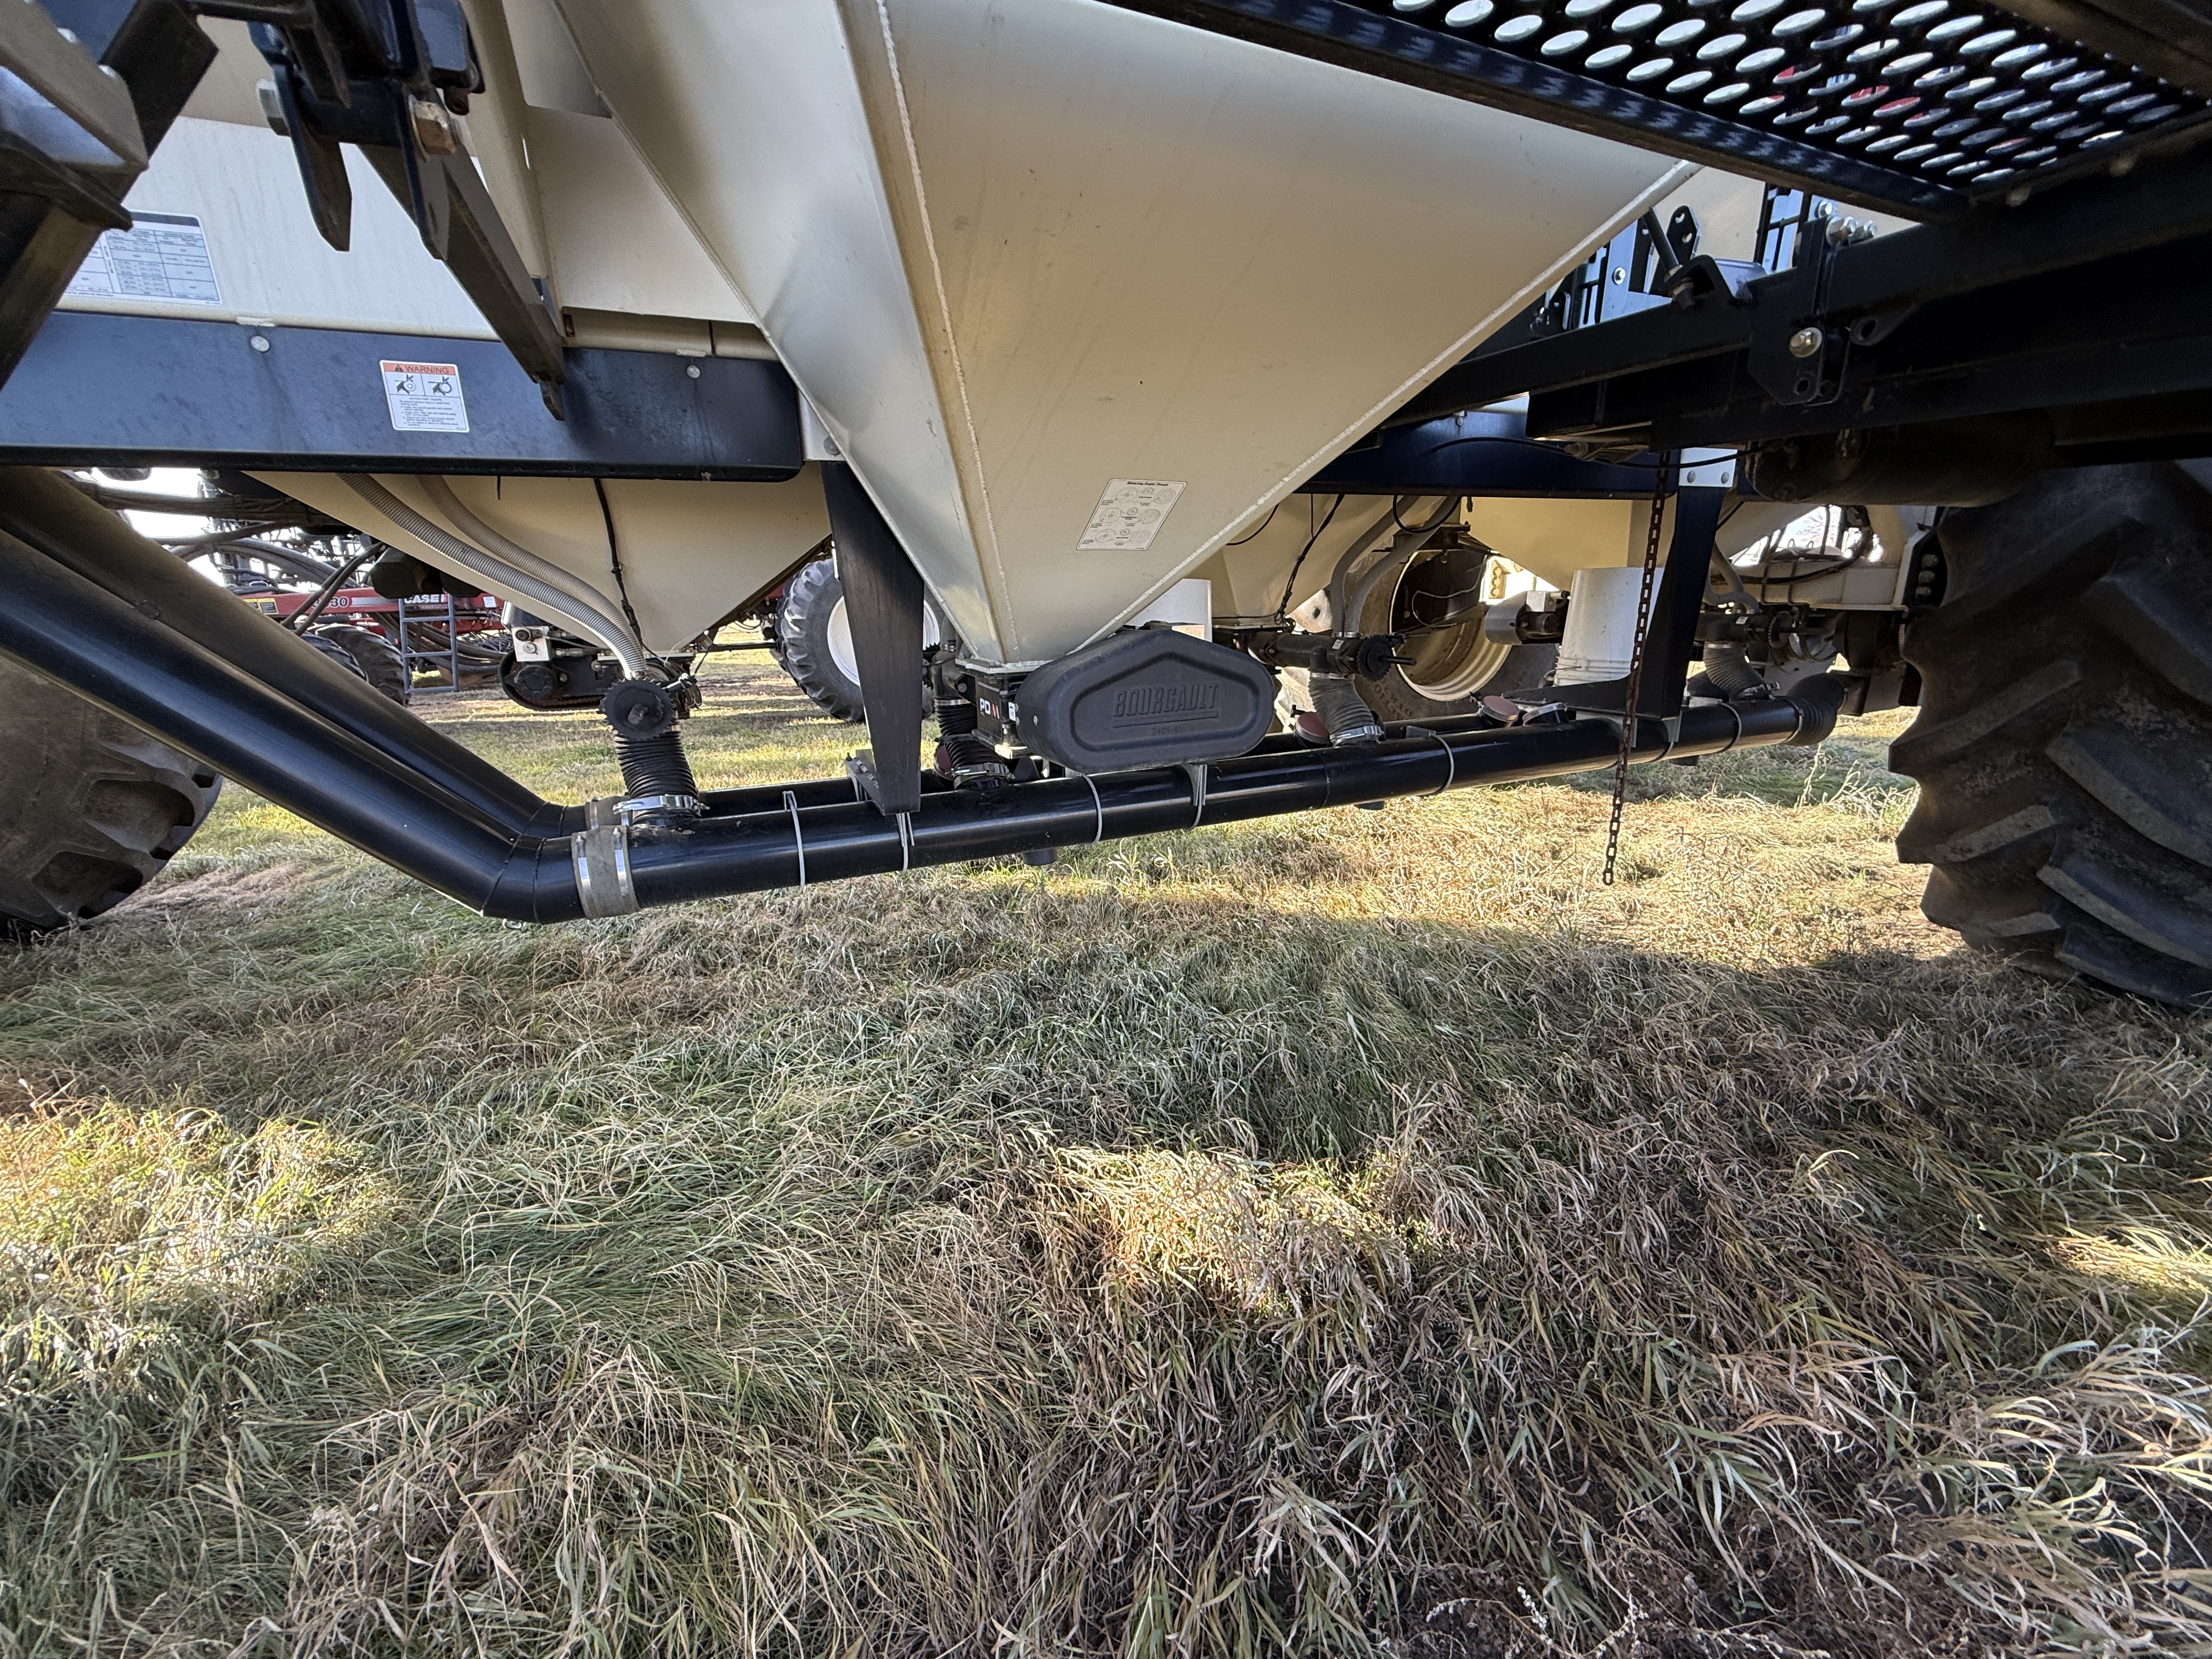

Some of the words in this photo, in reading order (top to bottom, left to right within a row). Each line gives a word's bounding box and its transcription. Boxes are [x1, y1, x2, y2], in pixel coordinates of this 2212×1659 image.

[405, 365, 449, 374] WARNING
[404, 594, 439, 603] CASE
[980, 697, 1000, 719] PDM
[1113, 684, 1219, 718] BOURGAULT
